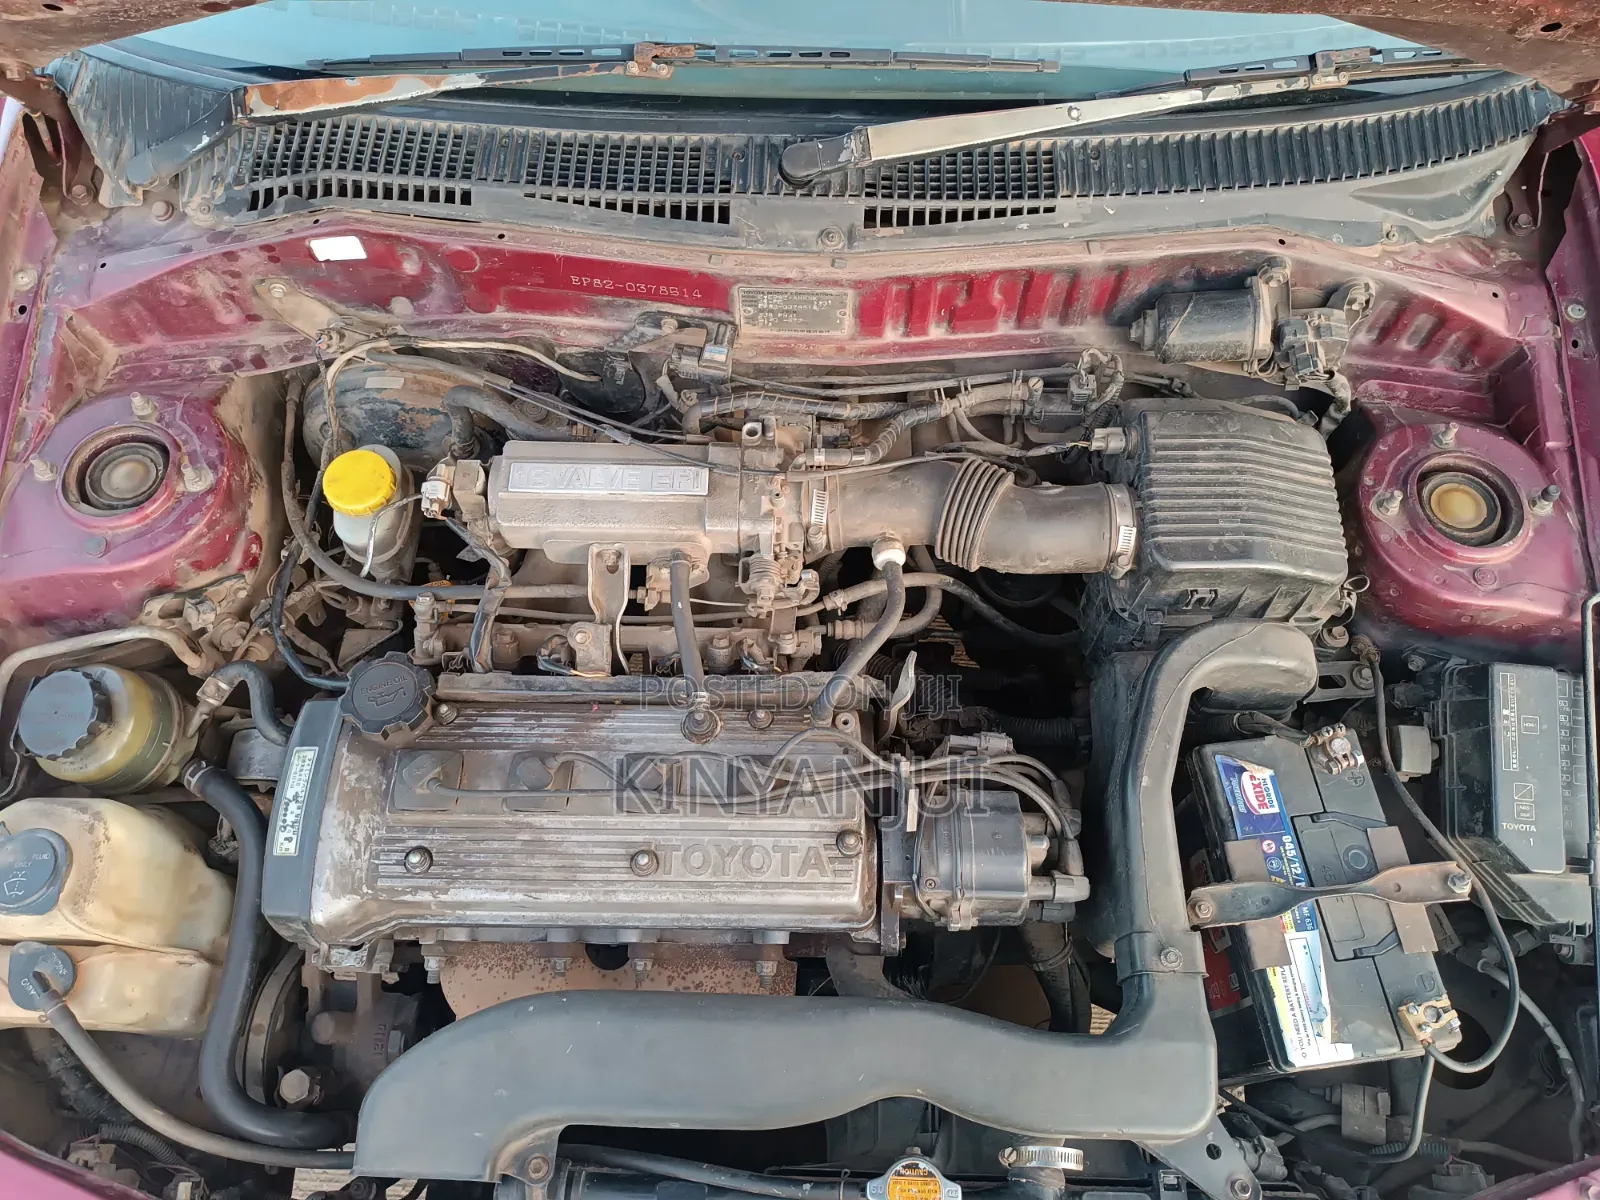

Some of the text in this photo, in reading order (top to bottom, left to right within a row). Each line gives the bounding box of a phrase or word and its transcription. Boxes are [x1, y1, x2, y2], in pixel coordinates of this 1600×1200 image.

[552, 466, 643, 490] VALVE
[651, 468, 700, 491] EFI
[360, 675, 408, 695] ENGINE OIL
[1261, 777, 1276, 809] HLORIDE
[1502, 822, 1536, 832] TOYOTA
[657, 843, 831, 878] TOYOTA
[1302, 906, 1314, 930] MF 636
[1283, 983, 1295, 1011] BATTERY
[1292, 1018, 1301, 1035] NEED
[1296, 1036, 1305, 1050] YOU
